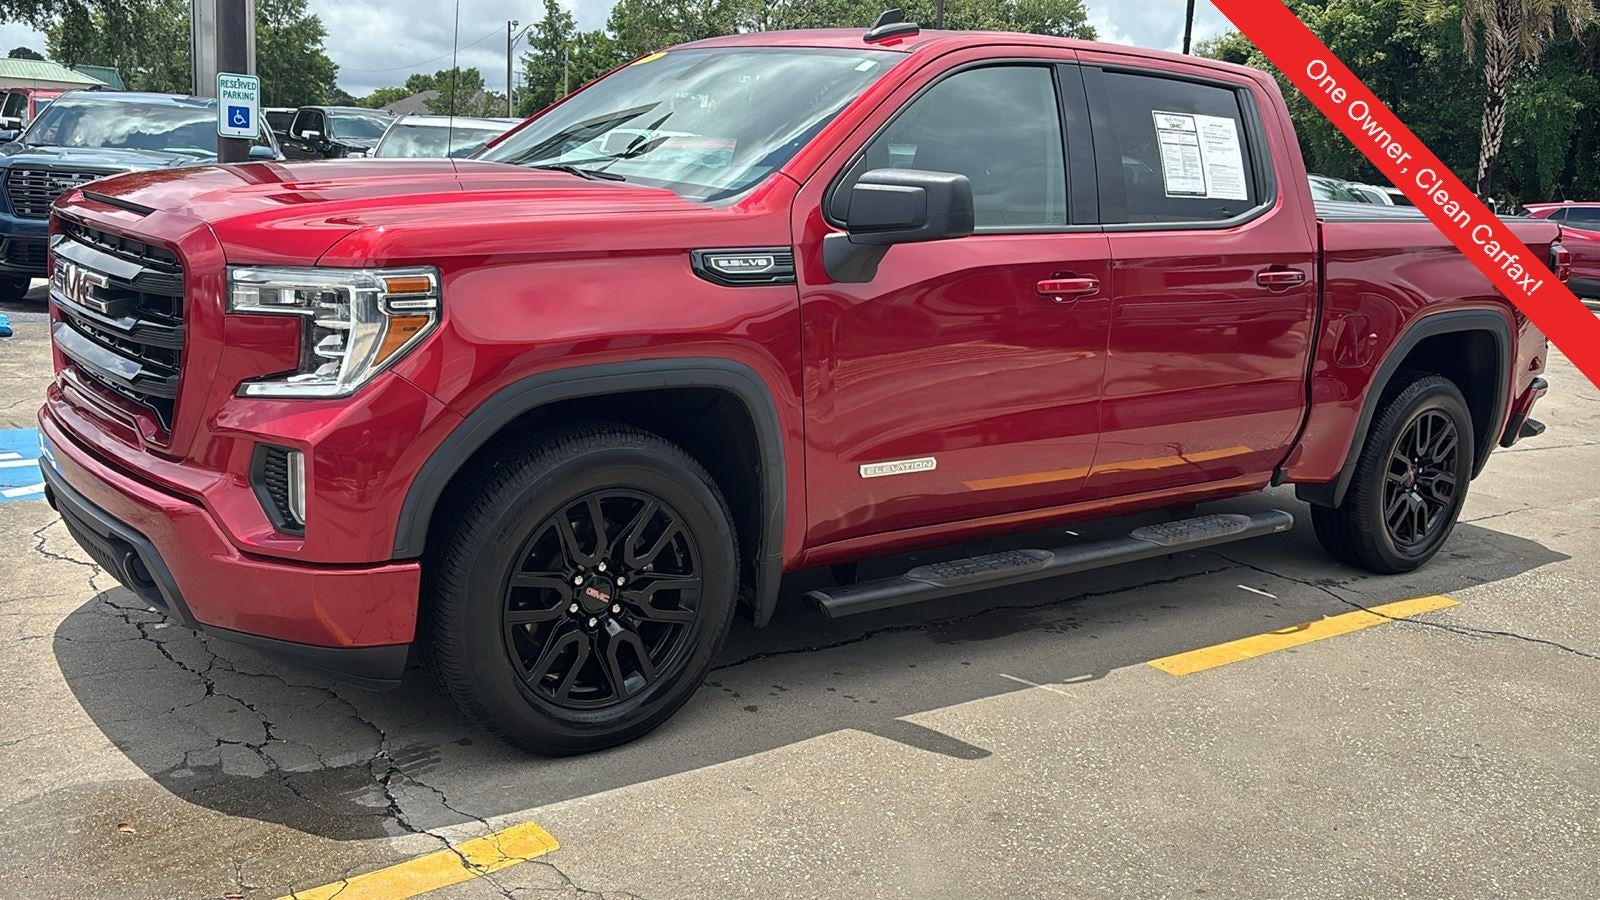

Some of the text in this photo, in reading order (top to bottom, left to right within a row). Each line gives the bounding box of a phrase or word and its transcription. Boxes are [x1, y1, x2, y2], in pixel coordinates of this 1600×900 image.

[220, 79, 257, 90] RESERVED
[223, 90, 255, 101] PARKING
[51, 258, 109, 314] GMC
[864, 459, 933, 475] ELEVATION
[585, 586, 611, 603] GMC
